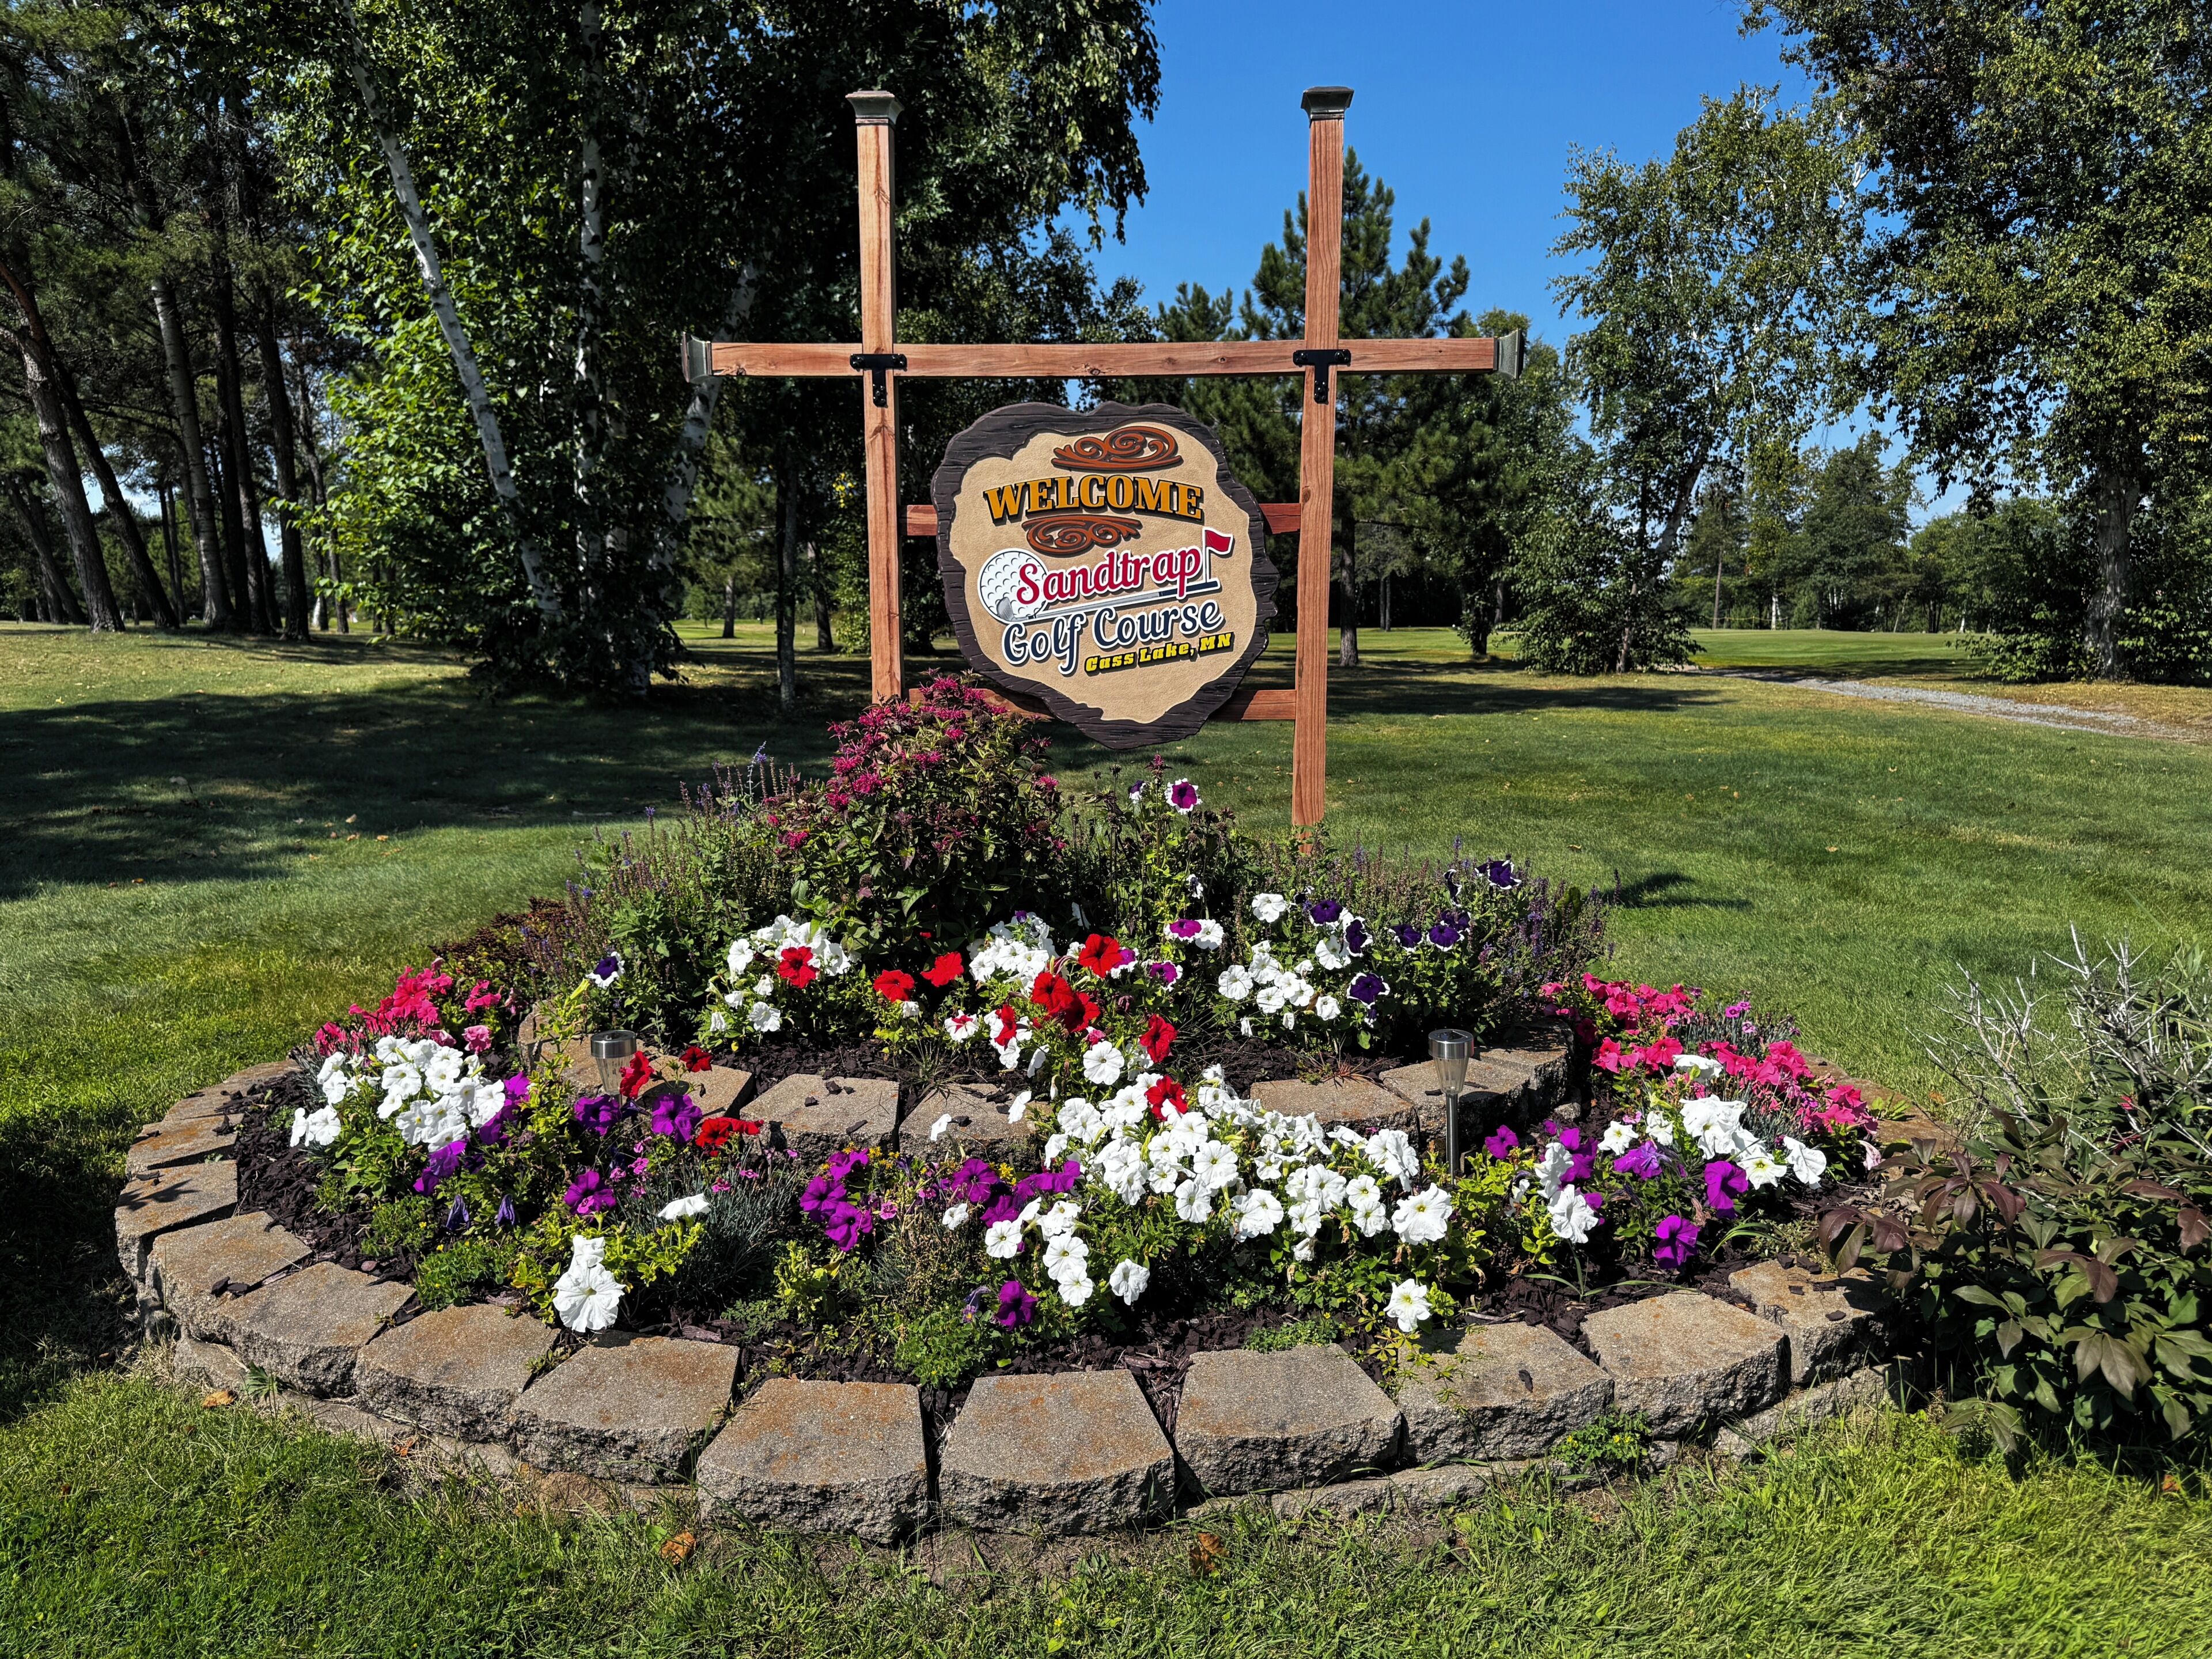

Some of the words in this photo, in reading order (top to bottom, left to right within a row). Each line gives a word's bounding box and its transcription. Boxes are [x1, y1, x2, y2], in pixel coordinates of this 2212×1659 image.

[984, 475, 1202, 521] WELCOME
[1017, 548, 1201, 604] Sandtrap
[1004, 613, 1085, 672] Golf
[1094, 602, 1221, 646] Course
[1086, 653, 1134, 672] Cass
[1139, 643, 1195, 662] Lake,
[1199, 633, 1232, 653] MN
